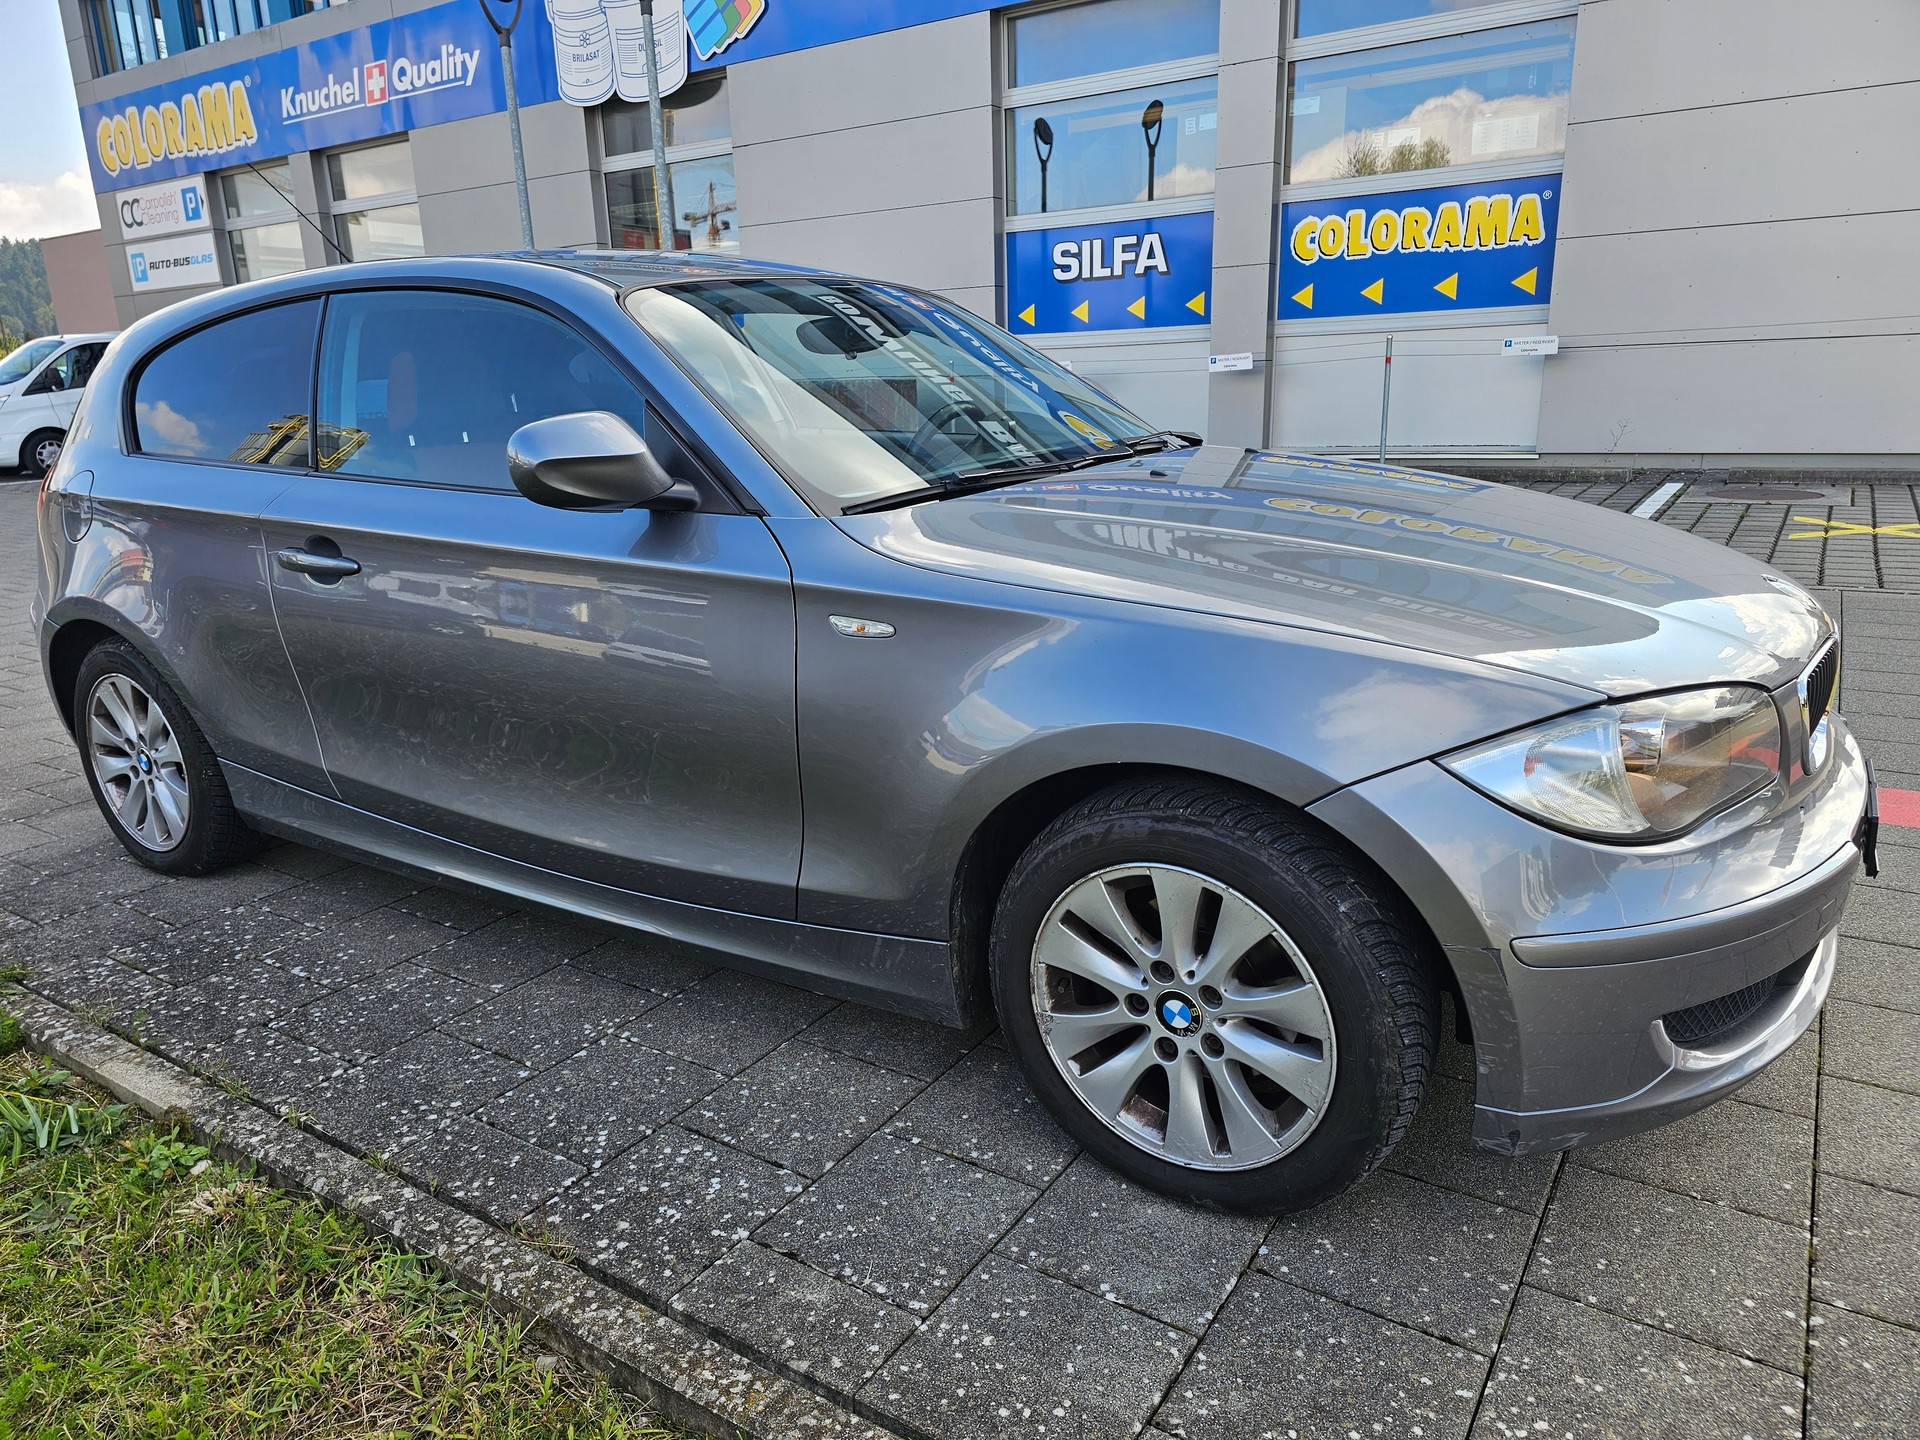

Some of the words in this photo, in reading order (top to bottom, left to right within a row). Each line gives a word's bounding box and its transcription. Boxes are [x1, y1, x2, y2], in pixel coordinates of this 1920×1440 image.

[638, 38, 663, 52] DUSIL
[572, 50, 600, 62] BRILASAT
[281, 67, 360, 118] Knuchel
[392, 44, 480, 92] Quality
[149, 254, 213, 271] AUTO-BUSGLAS
[1053, 233, 1170, 283] SILFA
